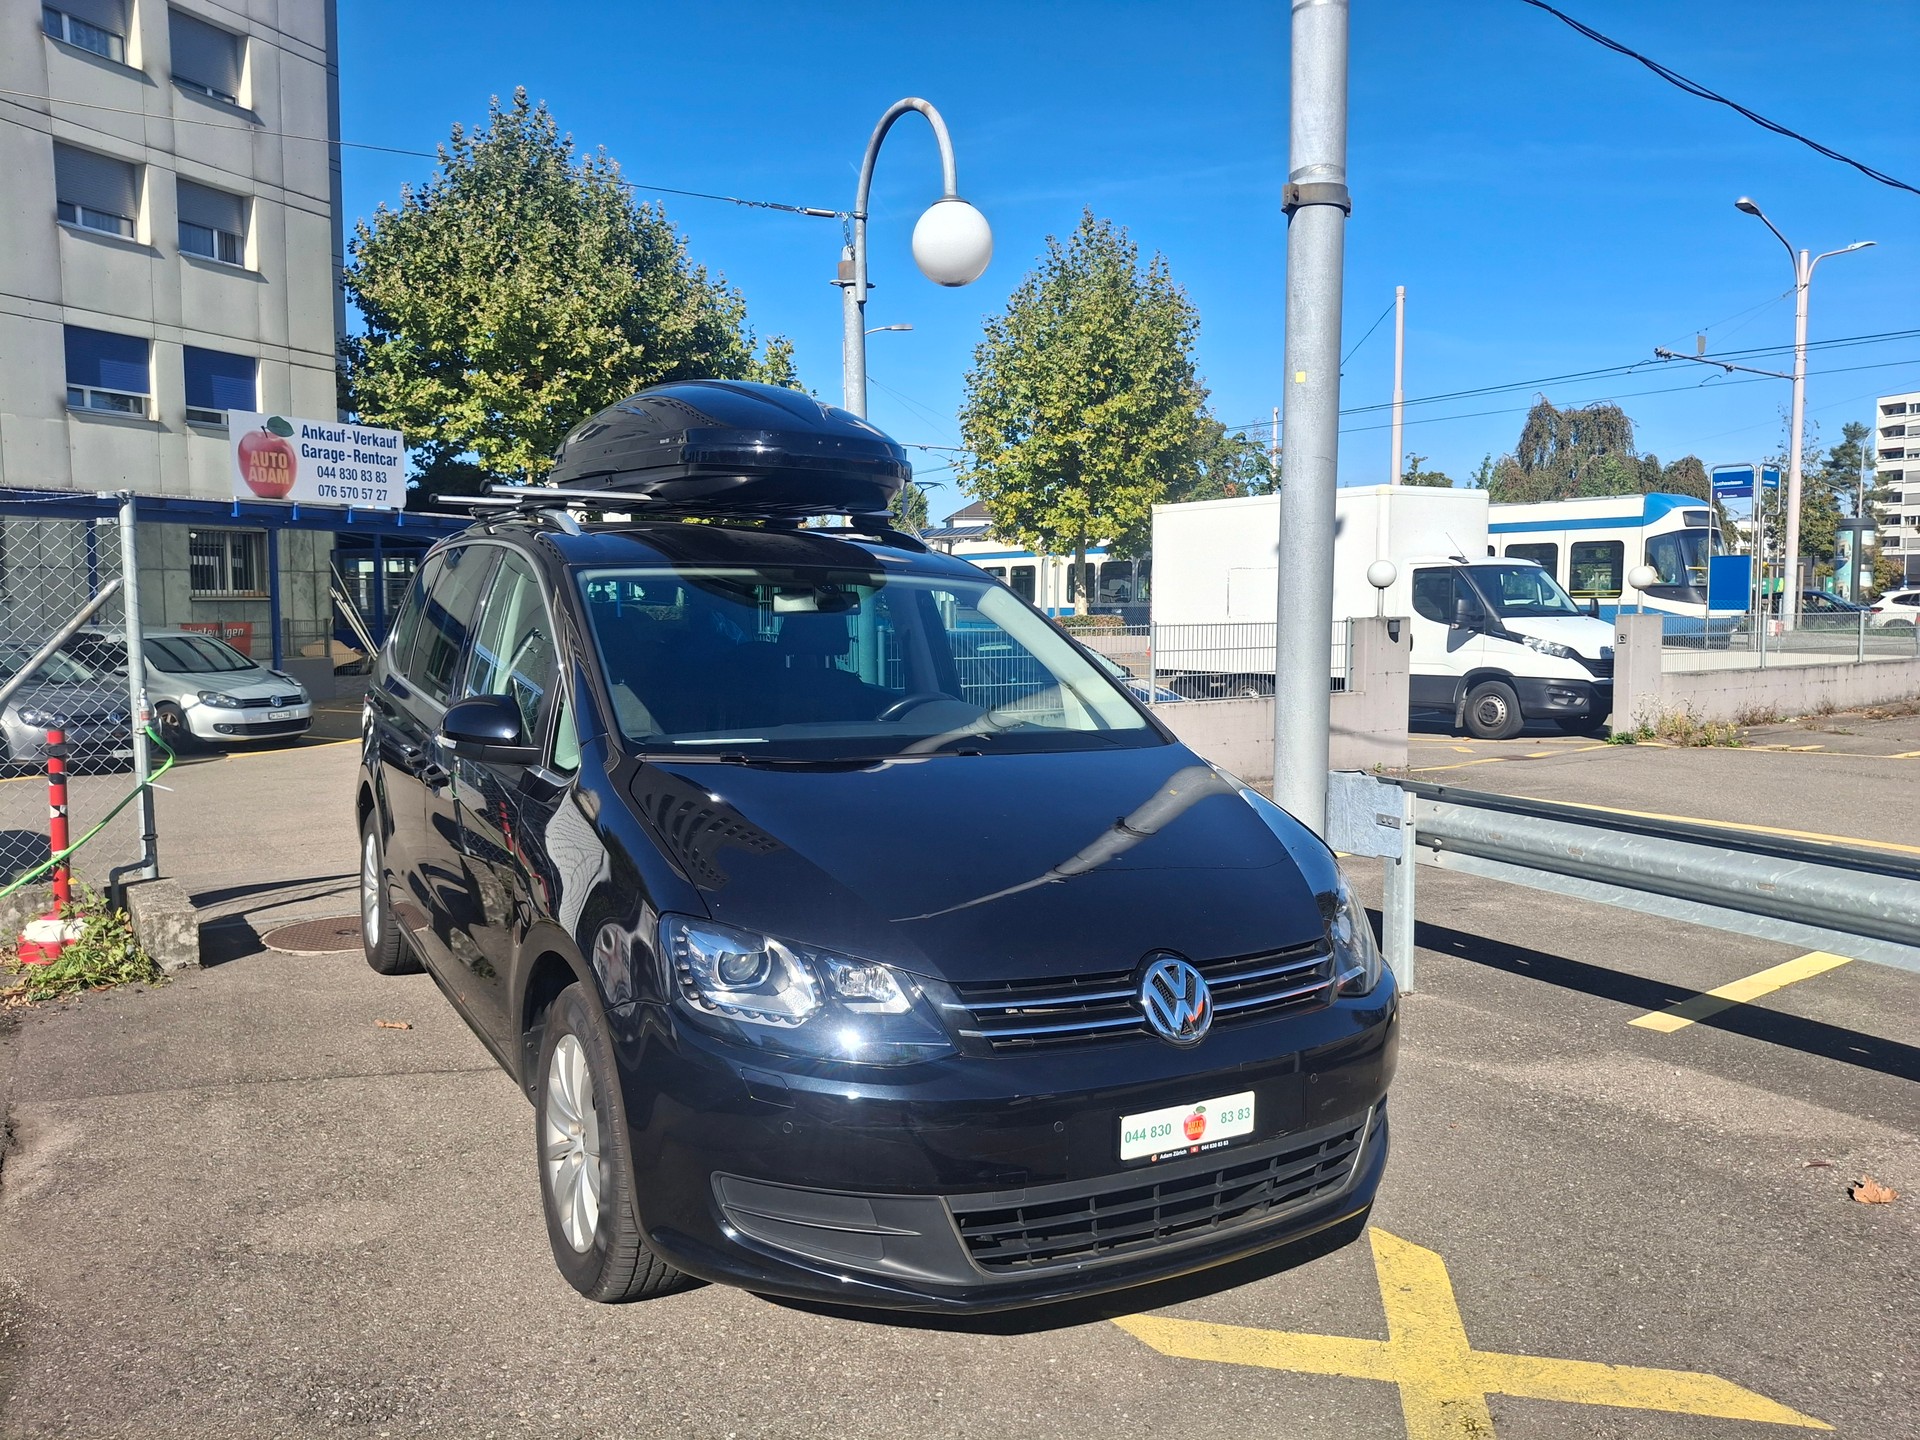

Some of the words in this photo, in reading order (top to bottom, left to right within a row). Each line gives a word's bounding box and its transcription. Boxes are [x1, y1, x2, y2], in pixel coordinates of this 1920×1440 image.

[301, 424, 397, 449] Ankauf-Verkauf
[250, 450, 288, 469] AUTO
[248, 466, 290, 484] ADAM
[317, 466, 336, 479] 044
[339, 468, 358, 481] 830
[360, 470, 373, 483] 83
[375, 471, 387, 484] 83
[318, 484, 338, 498] 076
[340, 486, 359, 499] 570
[361, 488, 373, 500] 57
[376, 489, 388, 501] 27
[1124, 1128, 1147, 1144] 044
[1150, 1123, 1172, 1138] 830
[1220, 1110, 1234, 1124] 83
[1237, 1107, 1251, 1121] 83
[1187, 1119, 1203, 1129] AUTO
[1160, 1152, 1172, 1160] Adam
